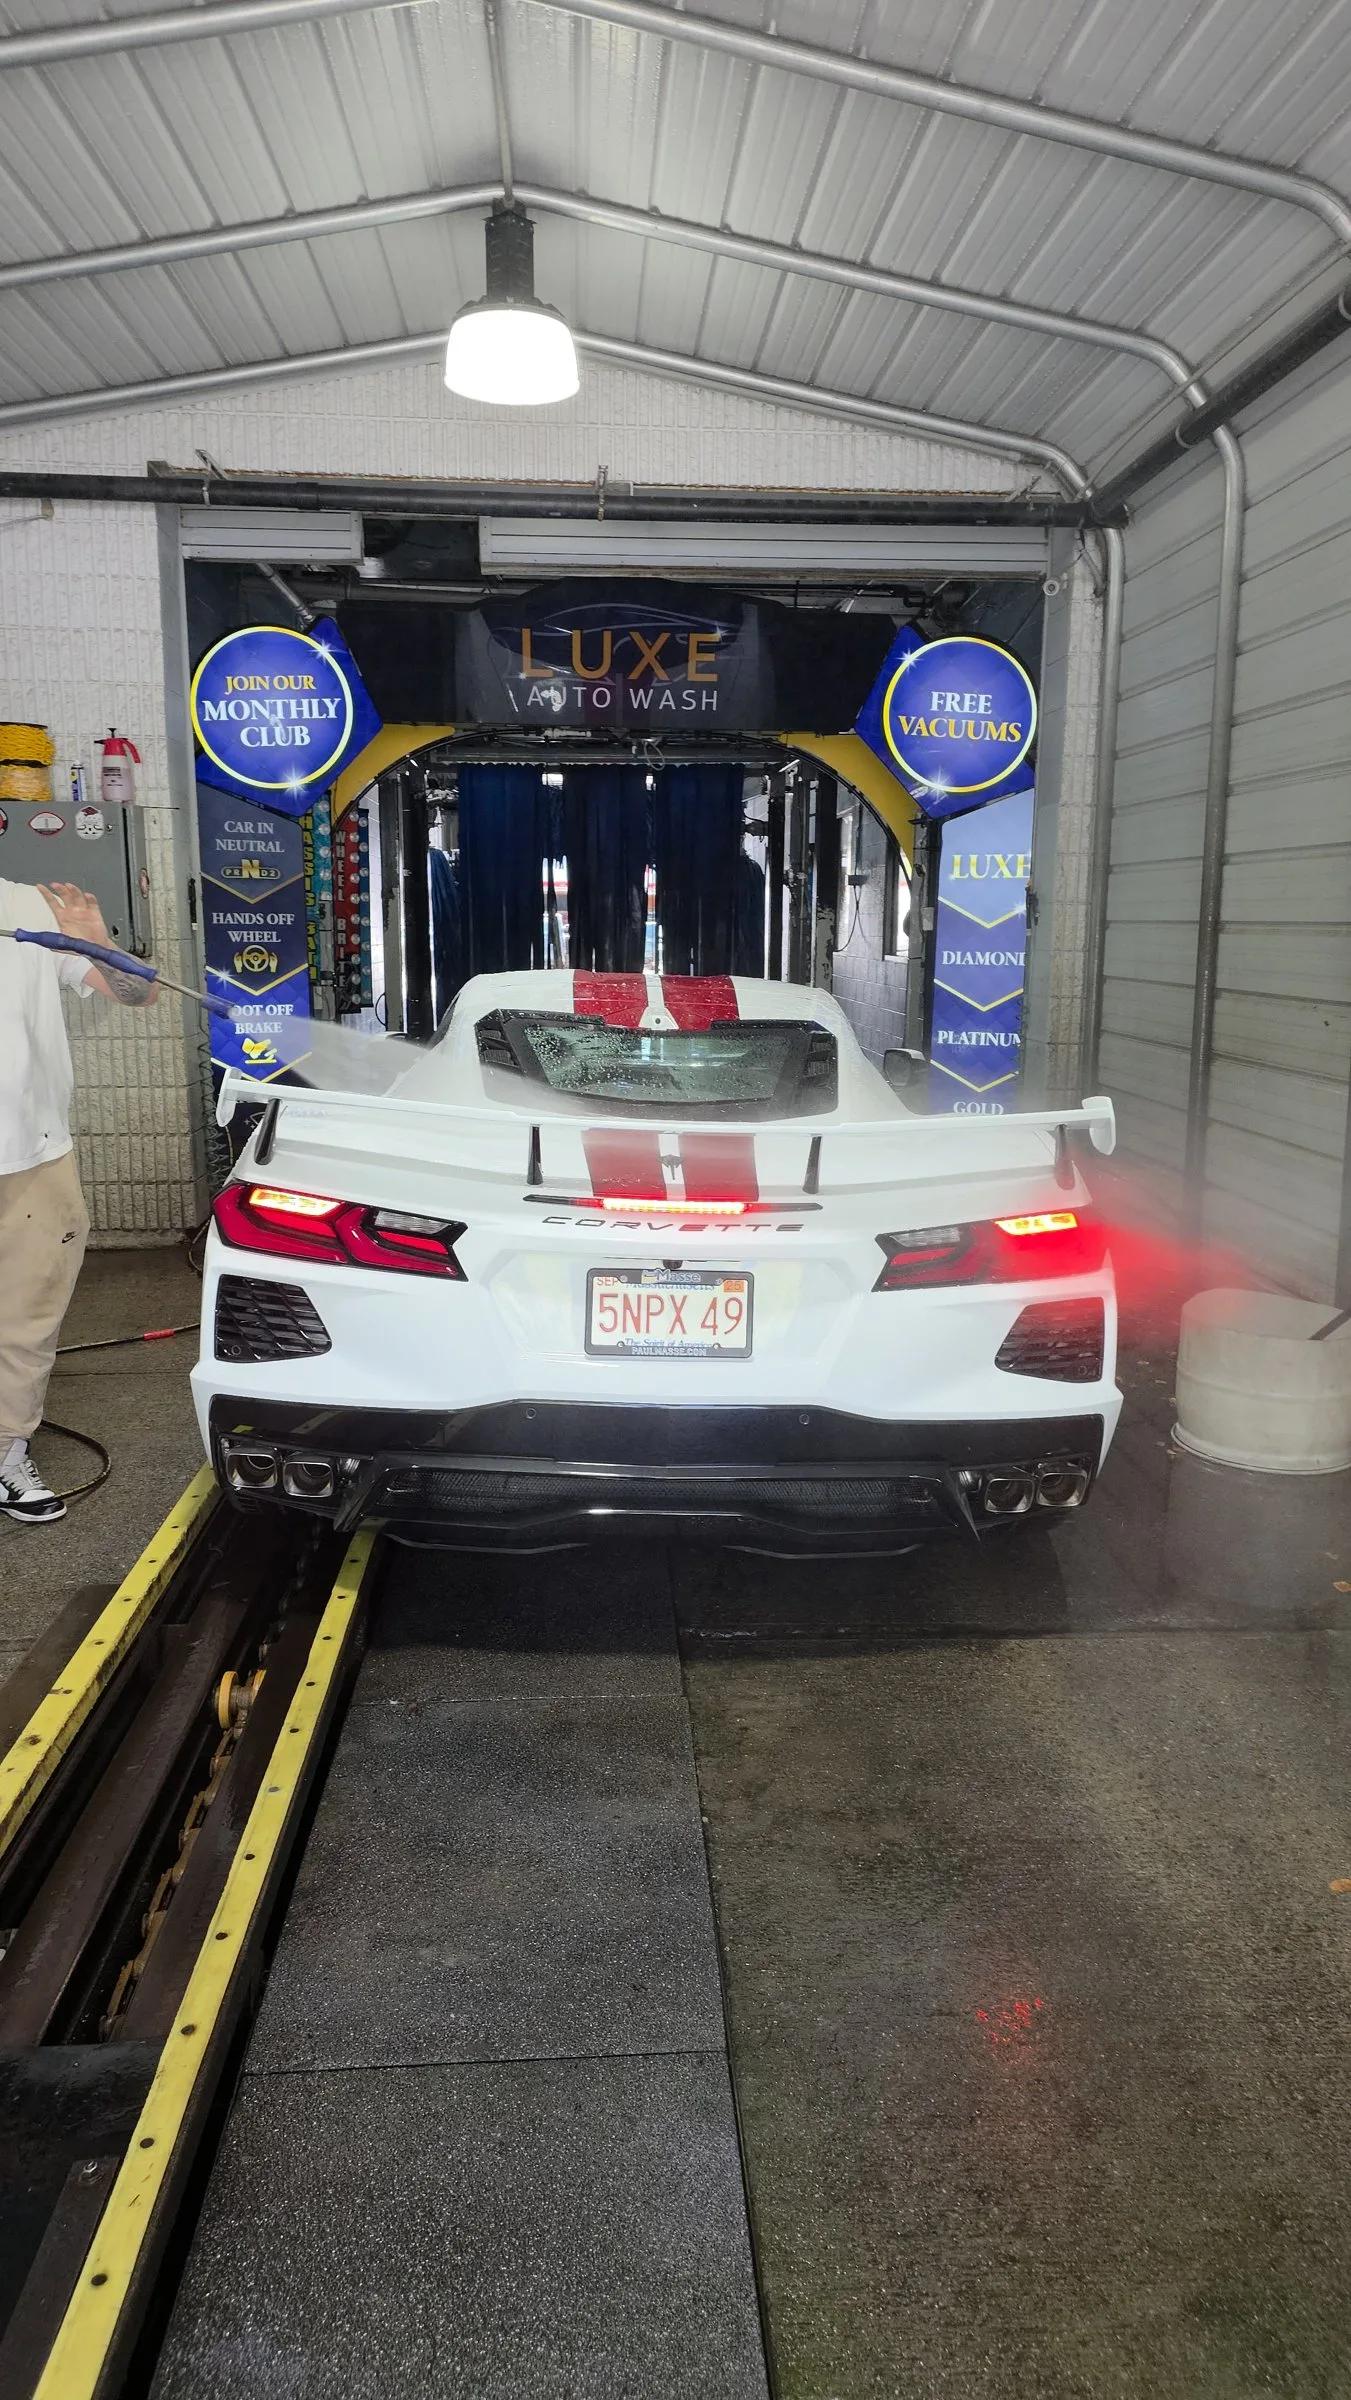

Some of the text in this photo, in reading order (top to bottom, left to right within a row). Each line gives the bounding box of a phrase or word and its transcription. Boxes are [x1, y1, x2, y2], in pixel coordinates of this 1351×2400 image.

[521, 628, 721, 682] LUXE
[225, 675, 316, 695] JOIN OUR
[527, 686, 718, 711] AUTO WASH
[930, 691, 993, 714] FREE
[202, 698, 341, 721] MONTHLY
[240, 725, 311, 747] CLUB
[898, 715, 1022, 743] VACUUMS
[224, 820, 274, 835] CAR IN
[215, 839, 284, 853] NEUTRAL
[299, 808, 316, 906] HASSIS
[952, 854, 1031, 879] LUXE
[335, 831, 347, 987] WHEEL BRITE
[212, 912, 295, 925] HANDS OFF
[227, 930, 281, 943] WHEEL
[230, 1004, 294, 1017] OOT OFF
[235, 1022, 283, 1035] BRAKE
[953, 1100, 1004, 1116] GOLD
[541, 1216, 805, 1232] CORVETTE
[656, 1269, 702, 1283] Masse
[726, 1281, 741, 1291] 25
[599, 1293, 743, 1336] 5NPX 49
[625, 1338, 641, 1346] The
[644, 1339, 667, 1347] Spirit
[668, 1339, 677, 1347] of
